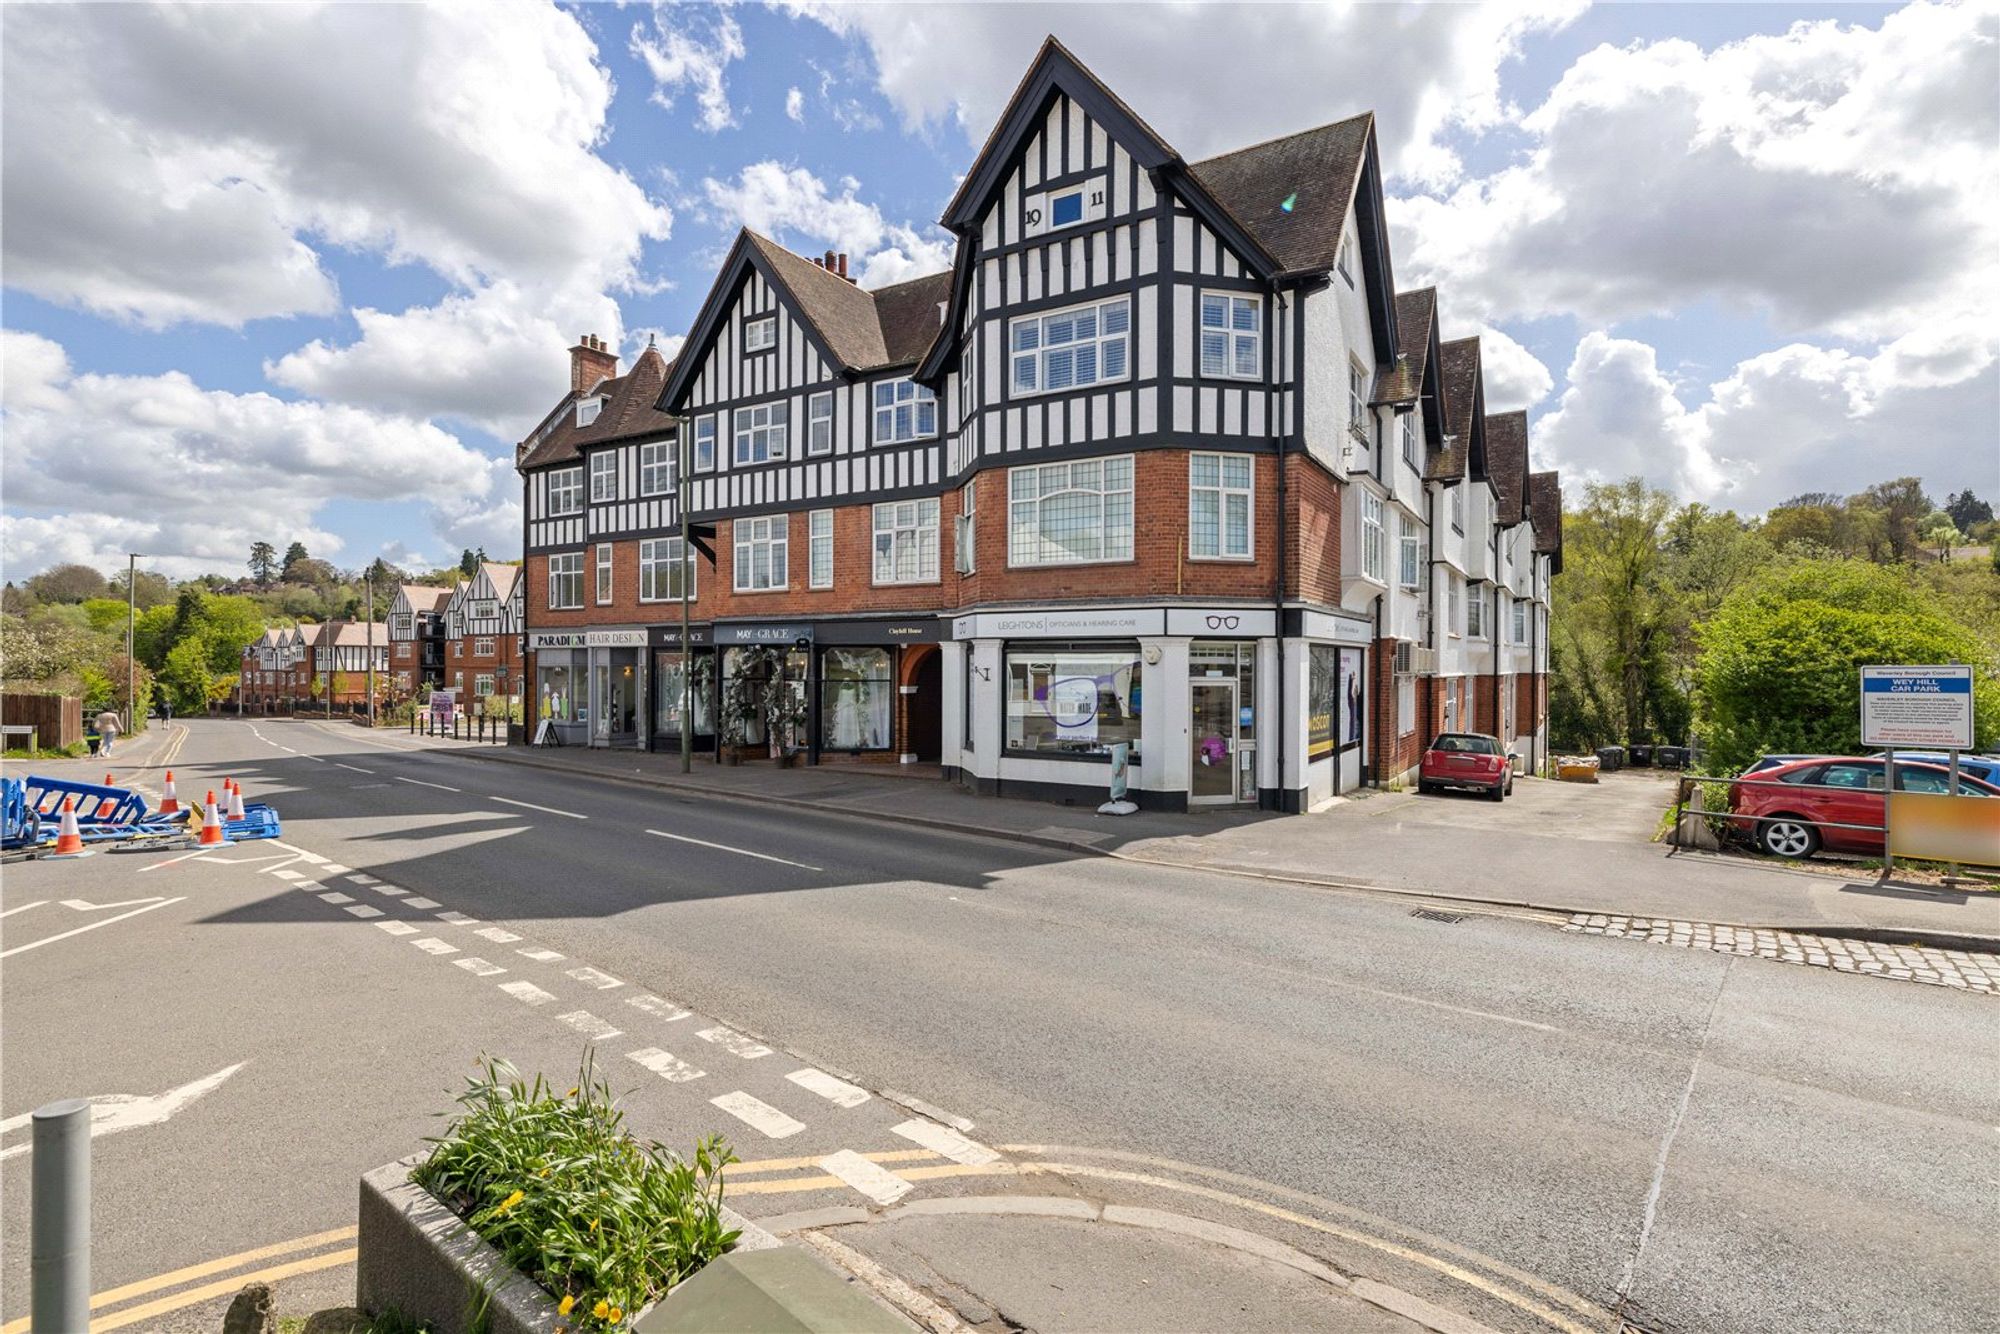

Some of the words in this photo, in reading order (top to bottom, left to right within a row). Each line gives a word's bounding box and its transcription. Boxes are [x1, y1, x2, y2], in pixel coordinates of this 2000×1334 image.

[1091, 191, 1104, 207] 11
[1026, 208, 1042, 227] 19
[998, 620, 1044, 630] LEIGHTONS
[1050, 620, 1081, 628] OPTICIANS
[1089, 619, 1118, 627] HEARING
[1119, 618, 1136, 627] CARE
[589, 633, 610, 644] HAIR
[663, 633, 676, 642] MAY
[679, 633, 703, 642] GACE
[736, 629, 752, 639] MAY
[757, 628, 789, 639] GRACE
